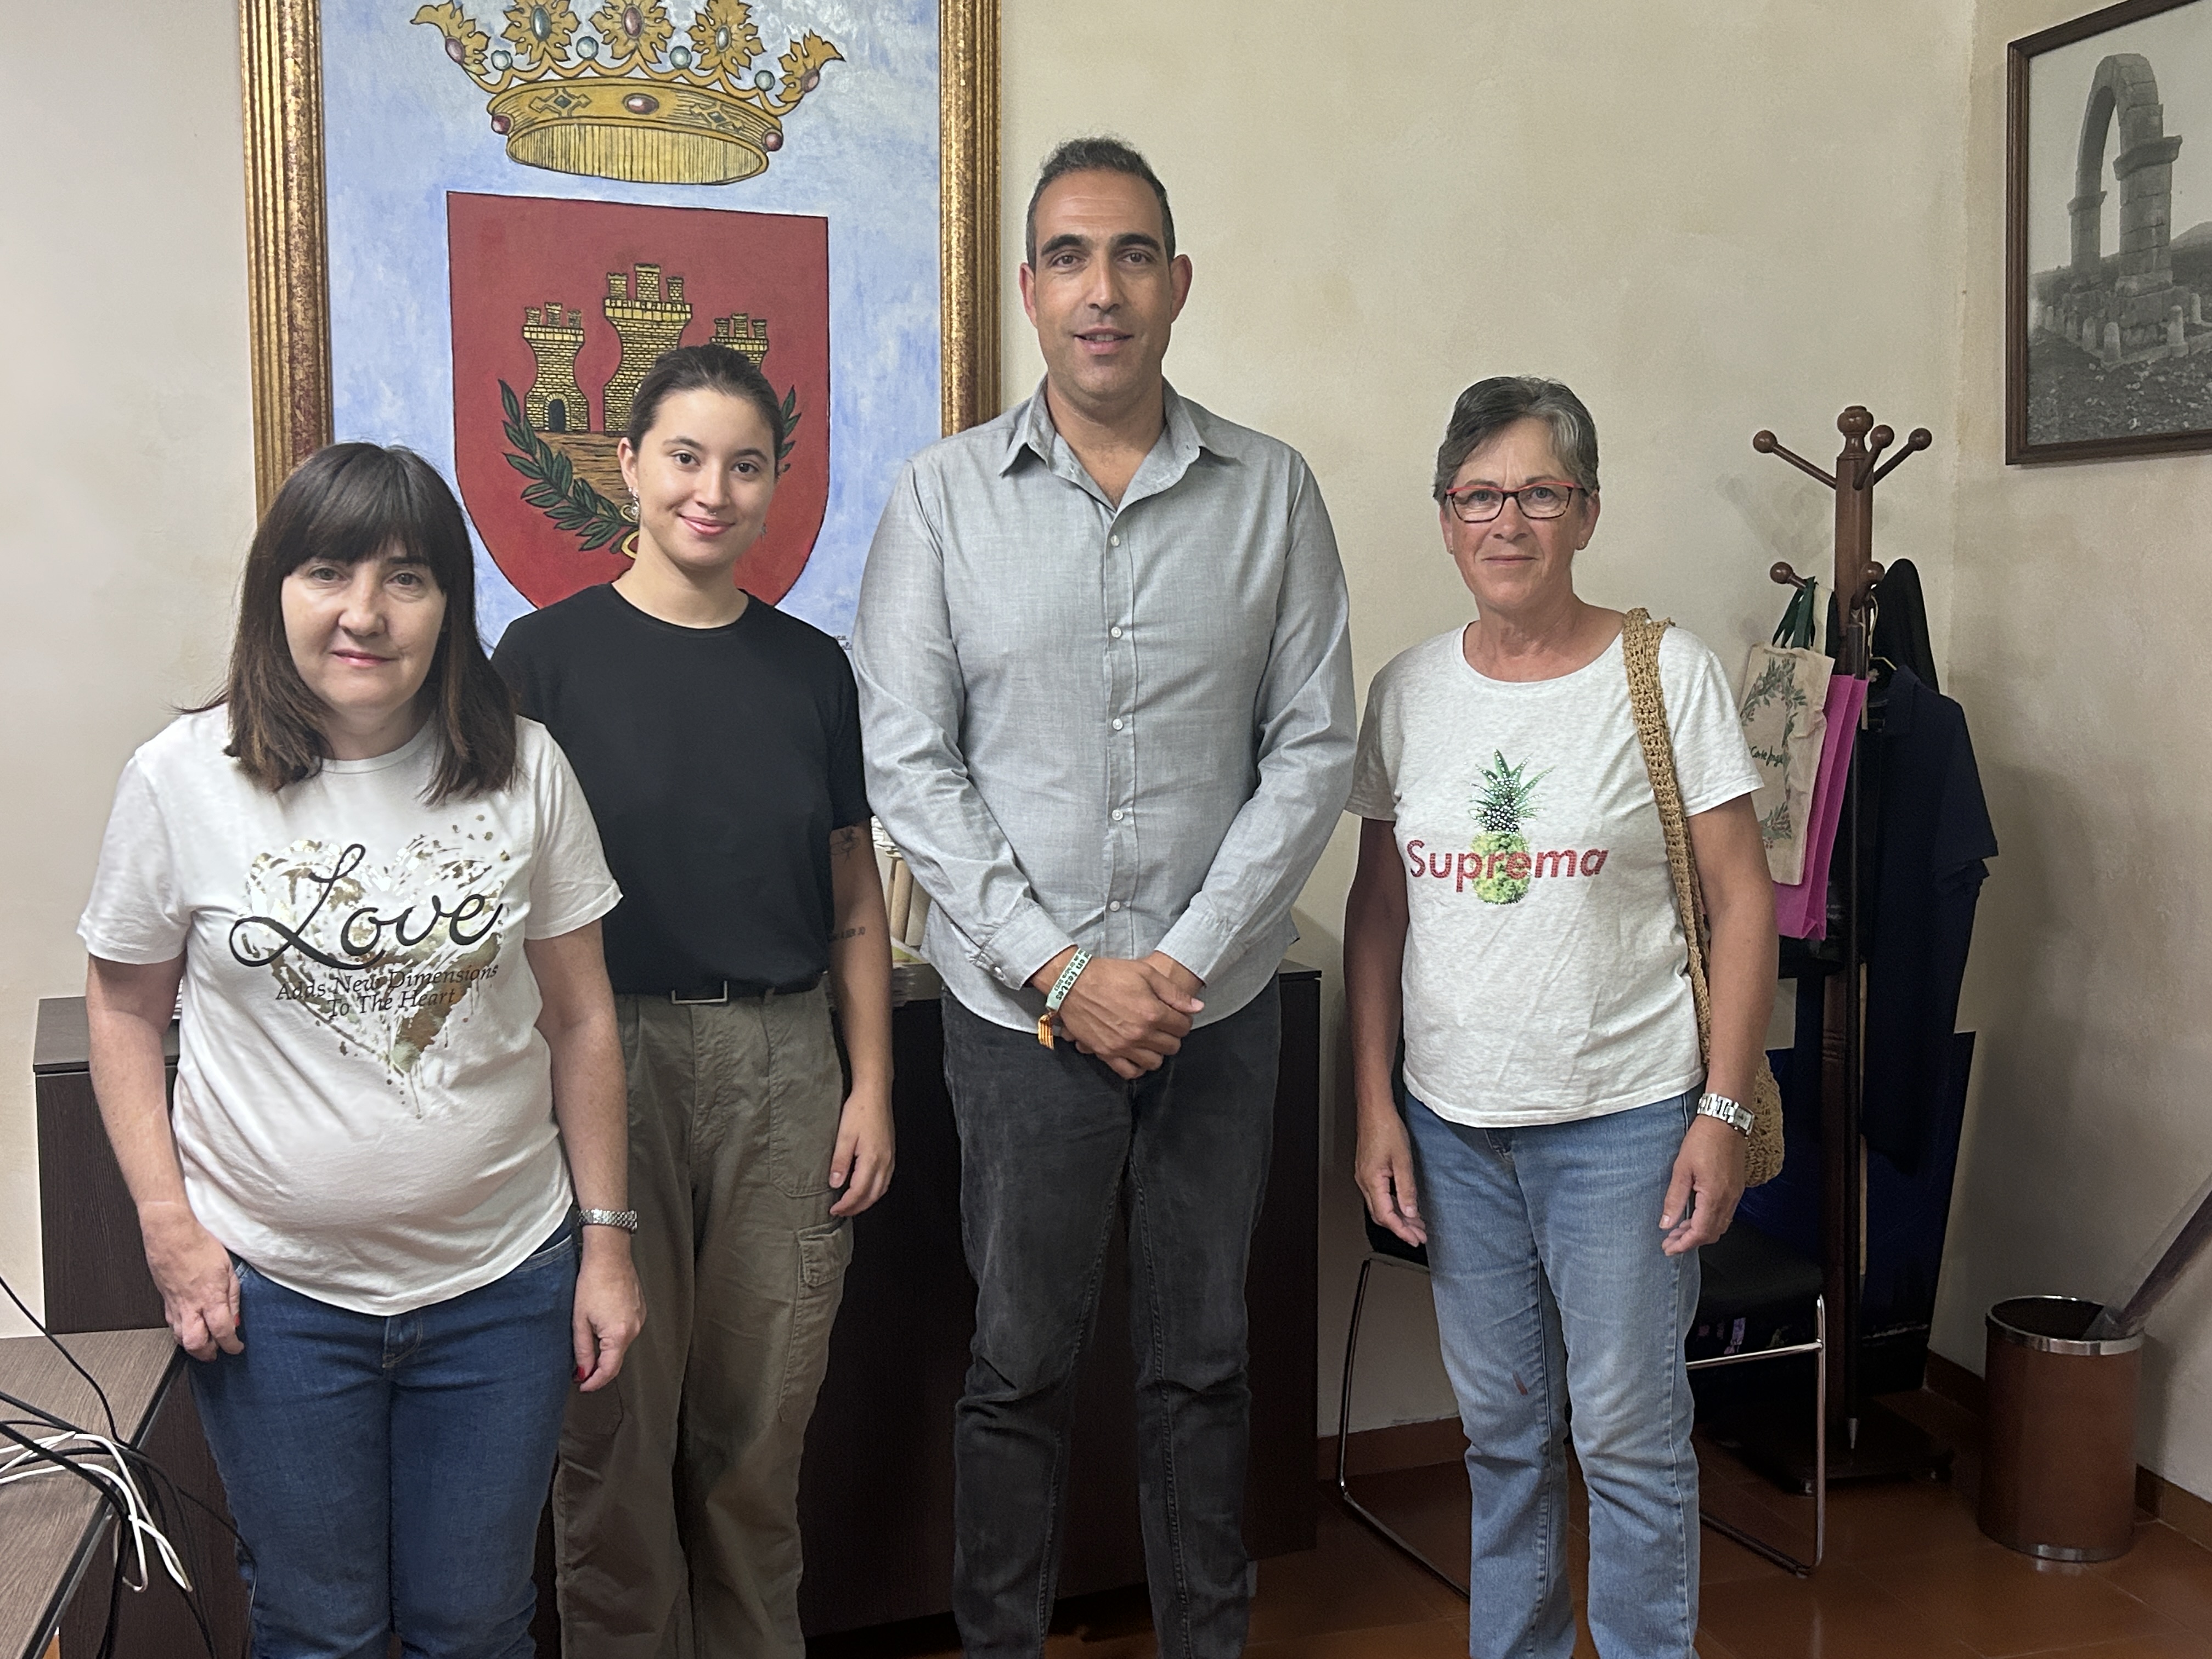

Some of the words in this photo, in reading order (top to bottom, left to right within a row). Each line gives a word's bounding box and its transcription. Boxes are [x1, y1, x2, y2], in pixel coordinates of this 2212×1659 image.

[1407, 839, 1609, 893] Suprema
[229, 843, 504, 970] Love
[275, 979, 326, 1001] Adds
[330, 974, 383, 995] New
[388, 964, 499, 989] Dimensions
[328, 997, 350, 1017] To
[357, 995, 393, 1014] The
[398, 988, 456, 1009] Heart
